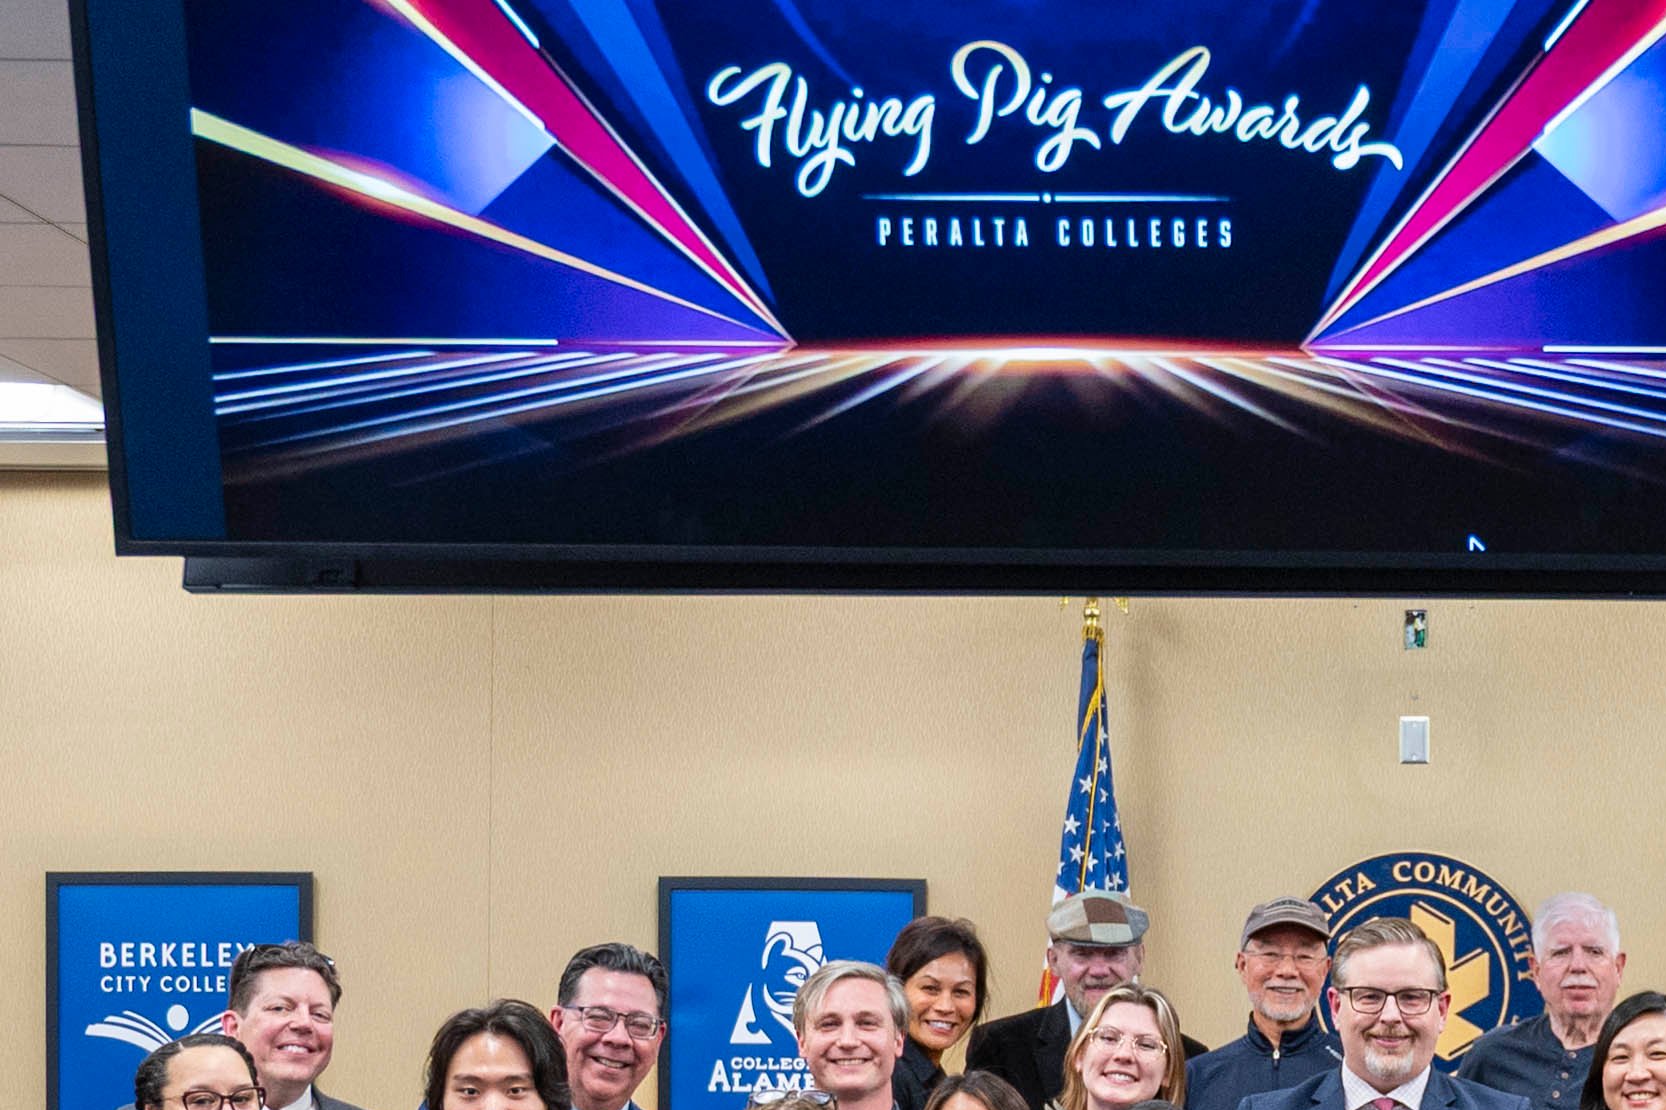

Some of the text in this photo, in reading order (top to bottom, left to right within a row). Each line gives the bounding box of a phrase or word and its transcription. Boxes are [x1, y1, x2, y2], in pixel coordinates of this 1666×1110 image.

[708, 40, 1403, 198] Flying Pig Awards
[878, 218, 1233, 248] PERALTA COLLEGES
[100, 975, 227, 993] CITY COLLE
[708, 1058, 816, 1092] ALAME
[730, 1056, 810, 1071] COLLEG
